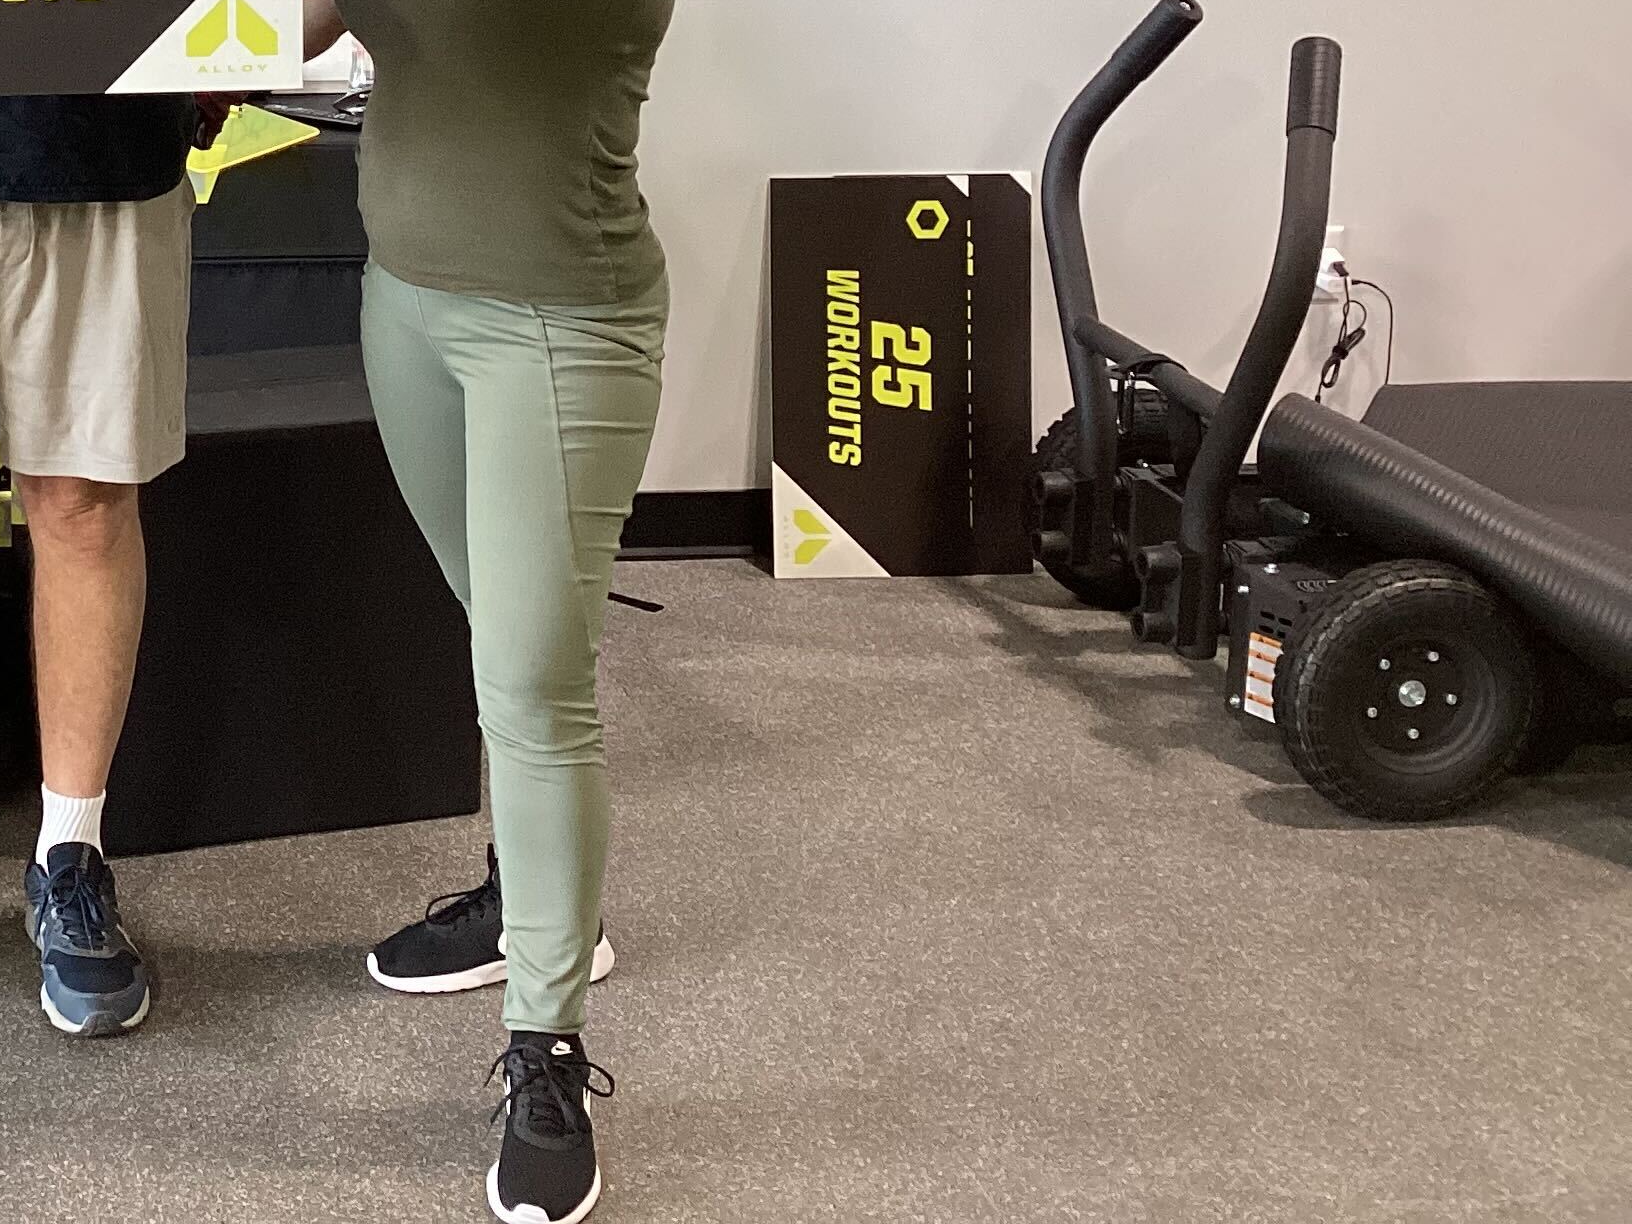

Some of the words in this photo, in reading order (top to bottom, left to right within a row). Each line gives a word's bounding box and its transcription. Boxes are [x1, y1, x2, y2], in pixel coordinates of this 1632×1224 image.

[197, 63, 269, 74] ALLOY
[826, 269, 862, 466] WORKOUTS
[871, 320, 933, 411] 25
